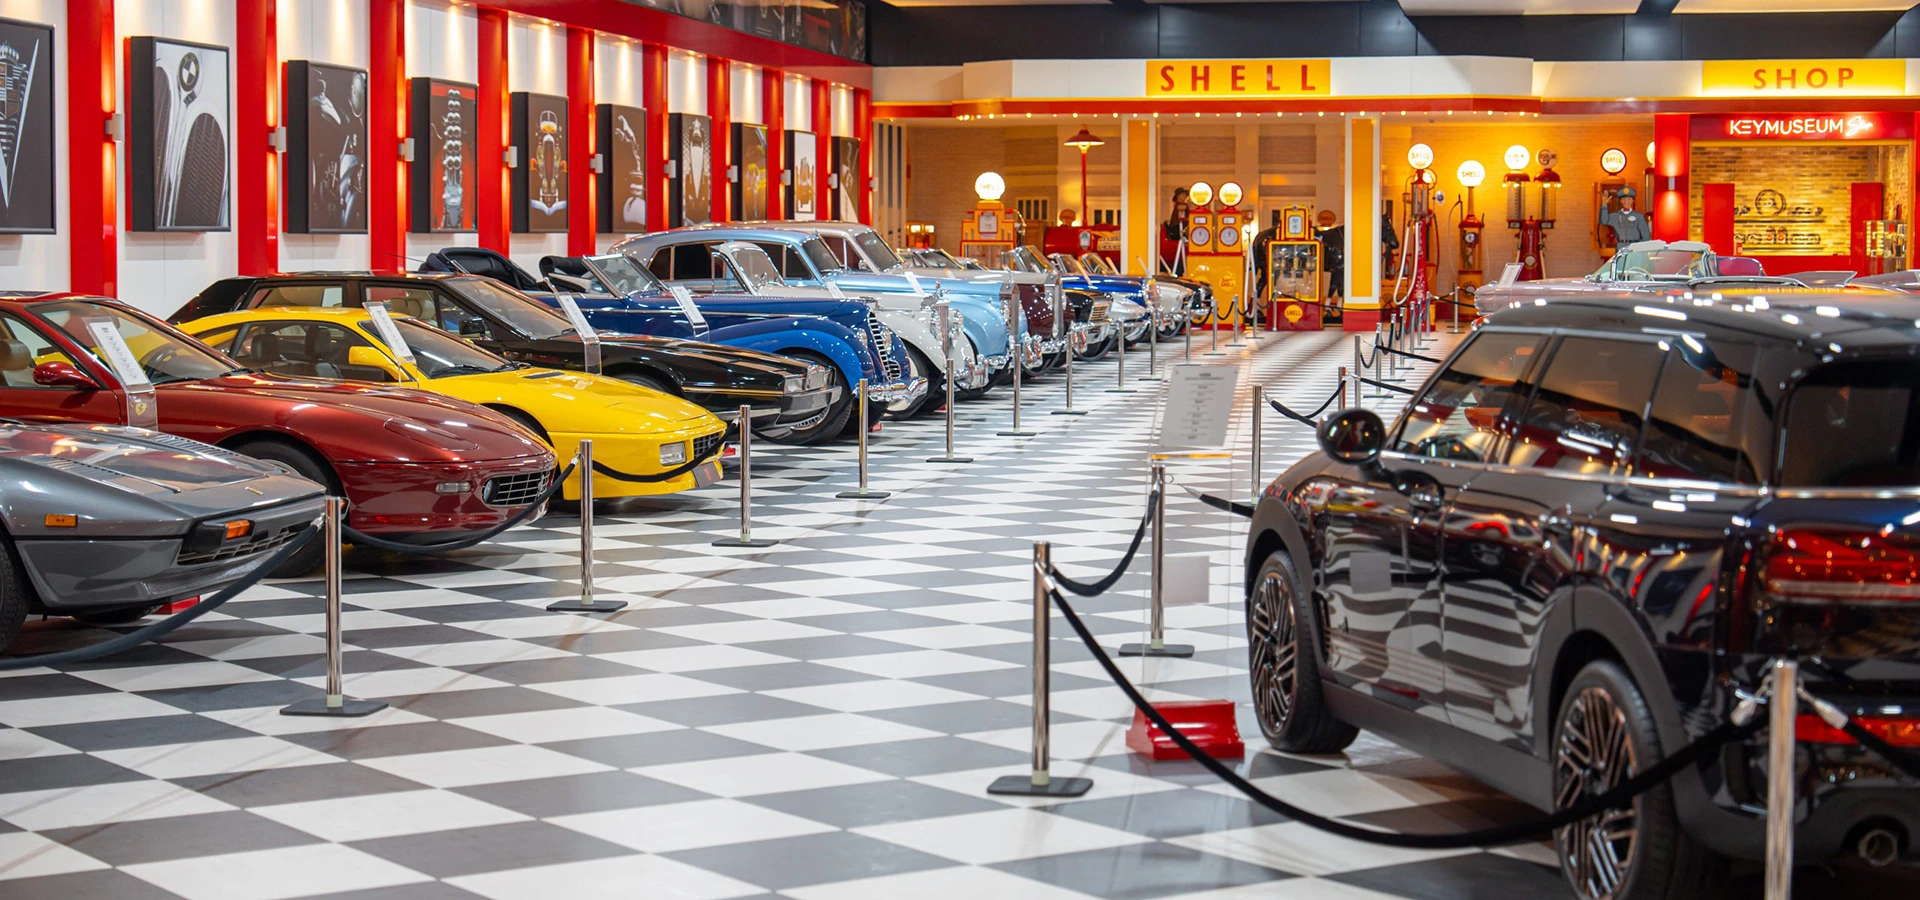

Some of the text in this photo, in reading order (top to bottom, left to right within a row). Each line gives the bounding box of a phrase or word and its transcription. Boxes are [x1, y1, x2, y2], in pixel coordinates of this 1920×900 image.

[1160, 65, 1316, 92] SHELL
[1753, 68, 1854, 90] SHOP
[1729, 118, 1844, 135] KEYMUSEUM
